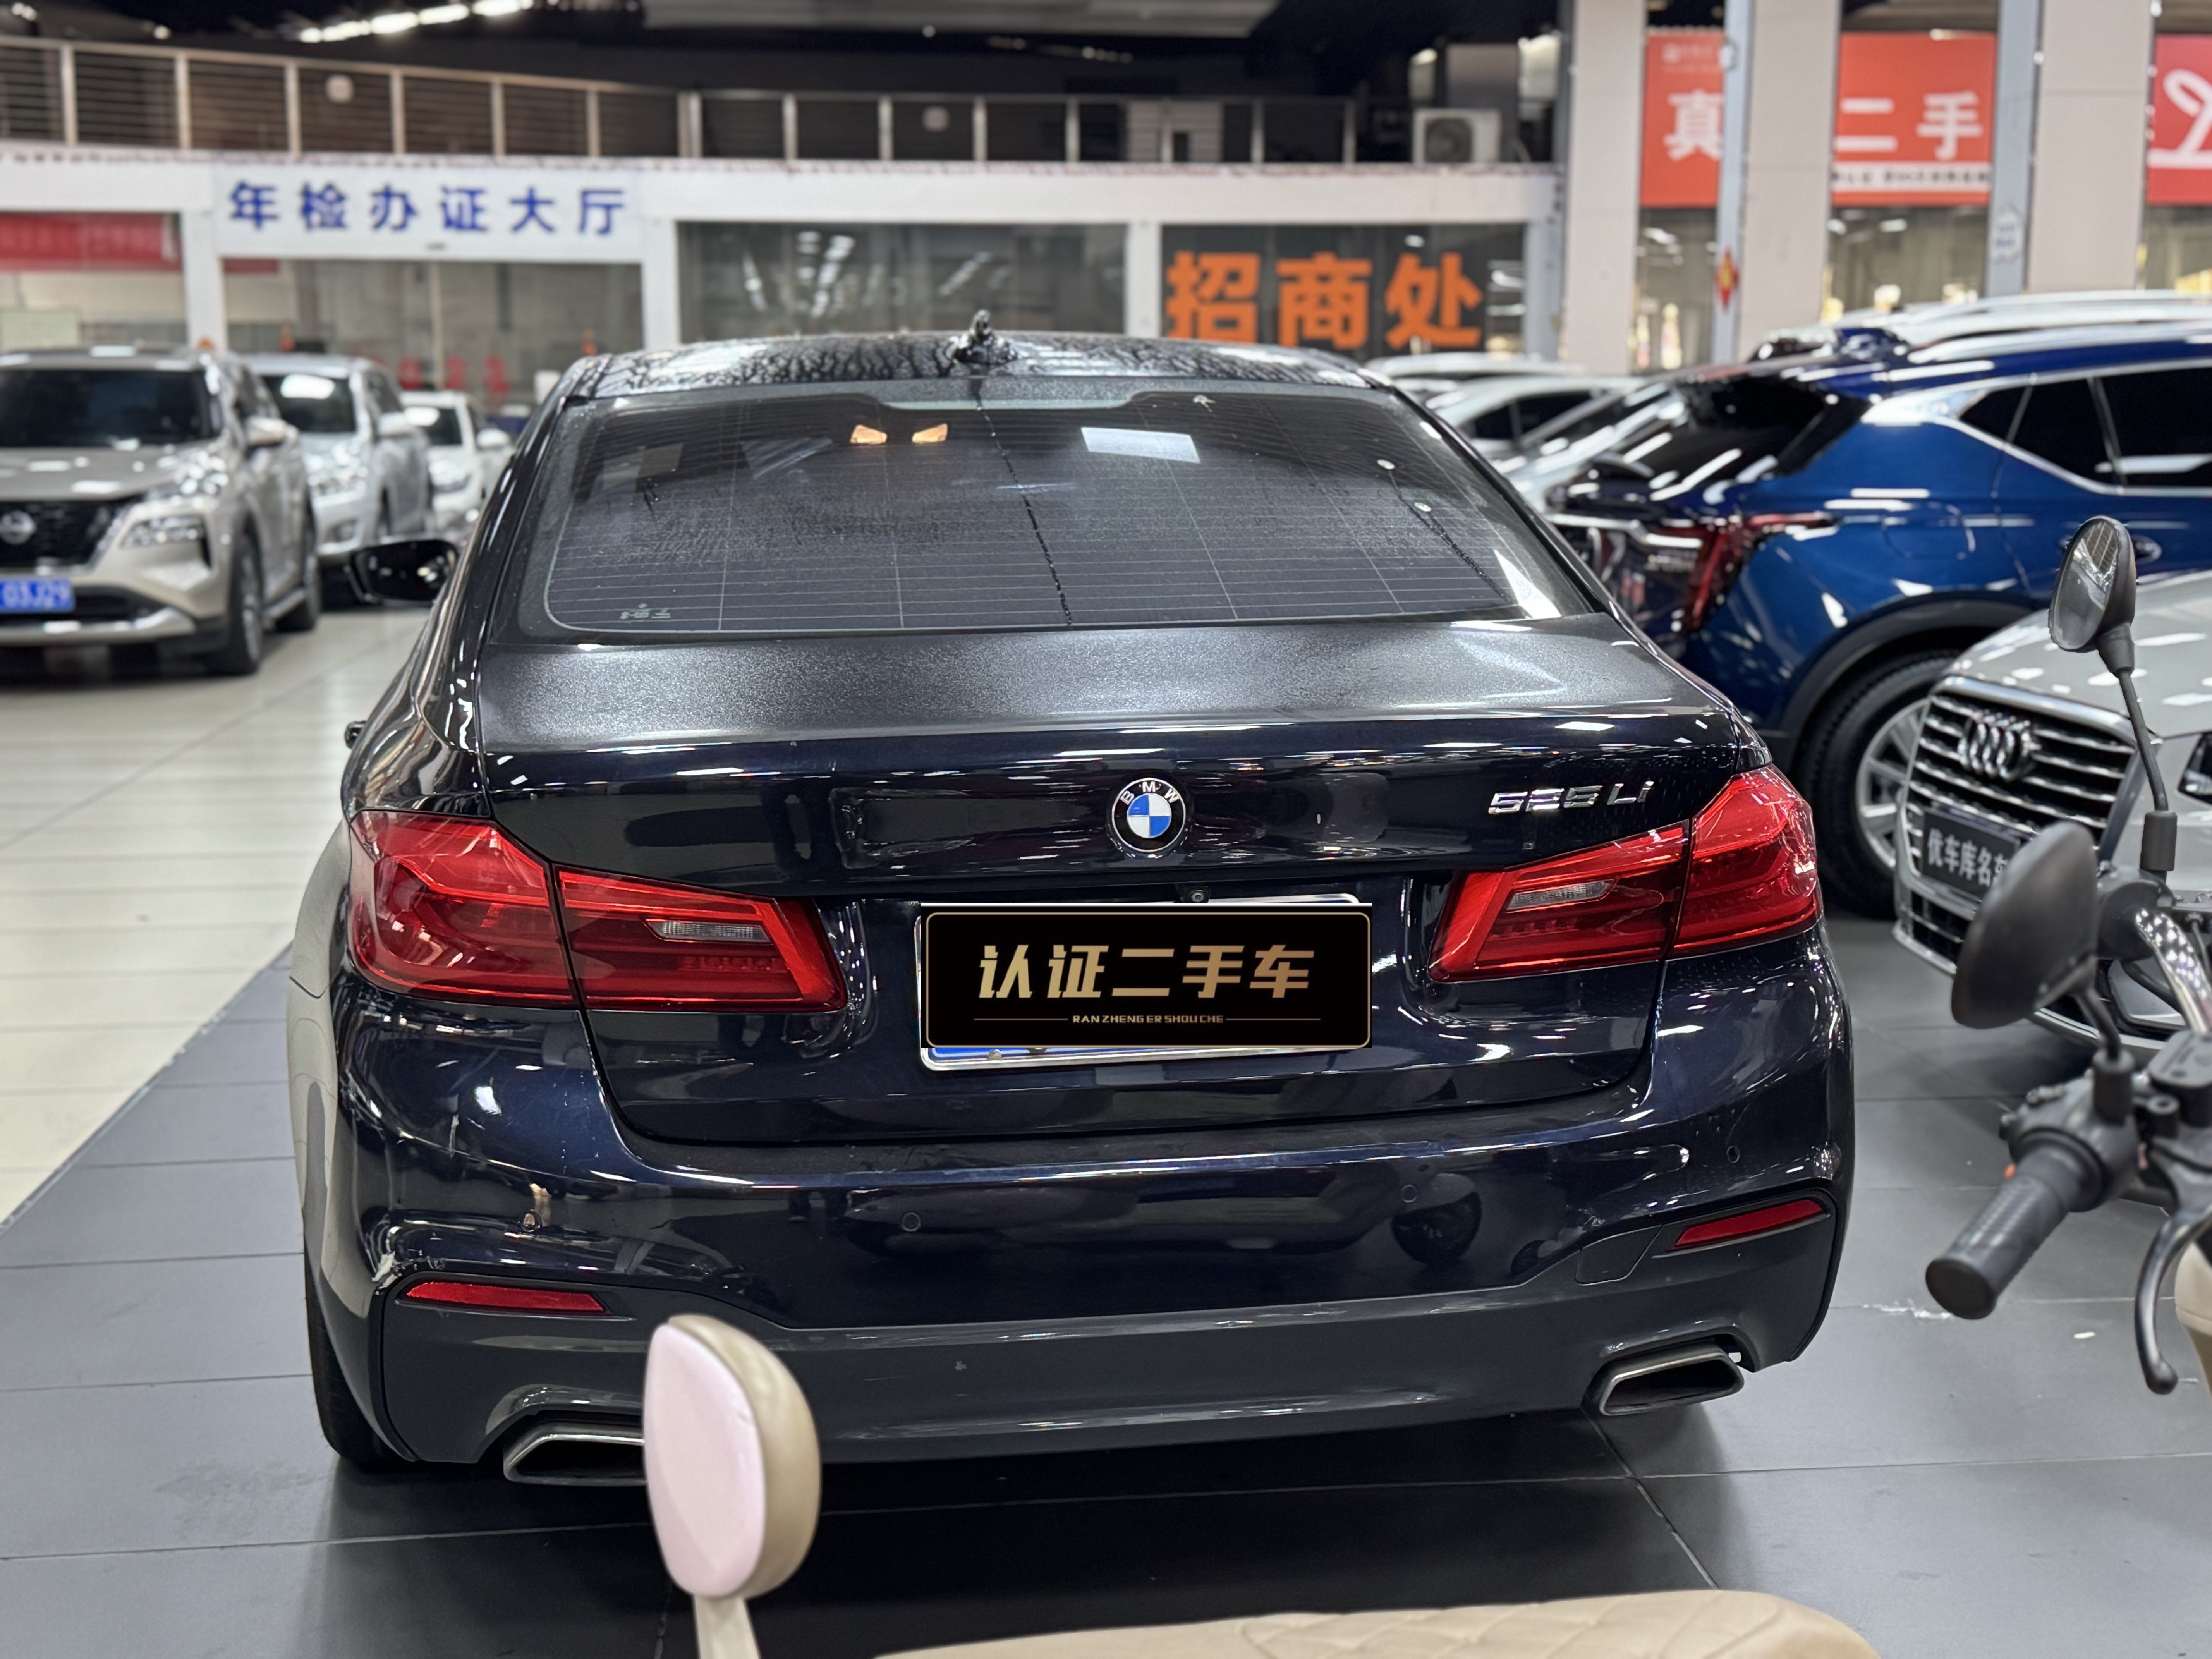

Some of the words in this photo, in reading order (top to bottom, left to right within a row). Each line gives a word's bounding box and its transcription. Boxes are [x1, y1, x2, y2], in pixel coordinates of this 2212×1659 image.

[1664, 90, 1724, 161] 真
[1833, 90, 1984, 160] 二手
[230, 180, 624, 235] 年检办证大厅
[1165, 250, 1484, 350] 招商处
[1120, 781, 1179, 805] BMW
